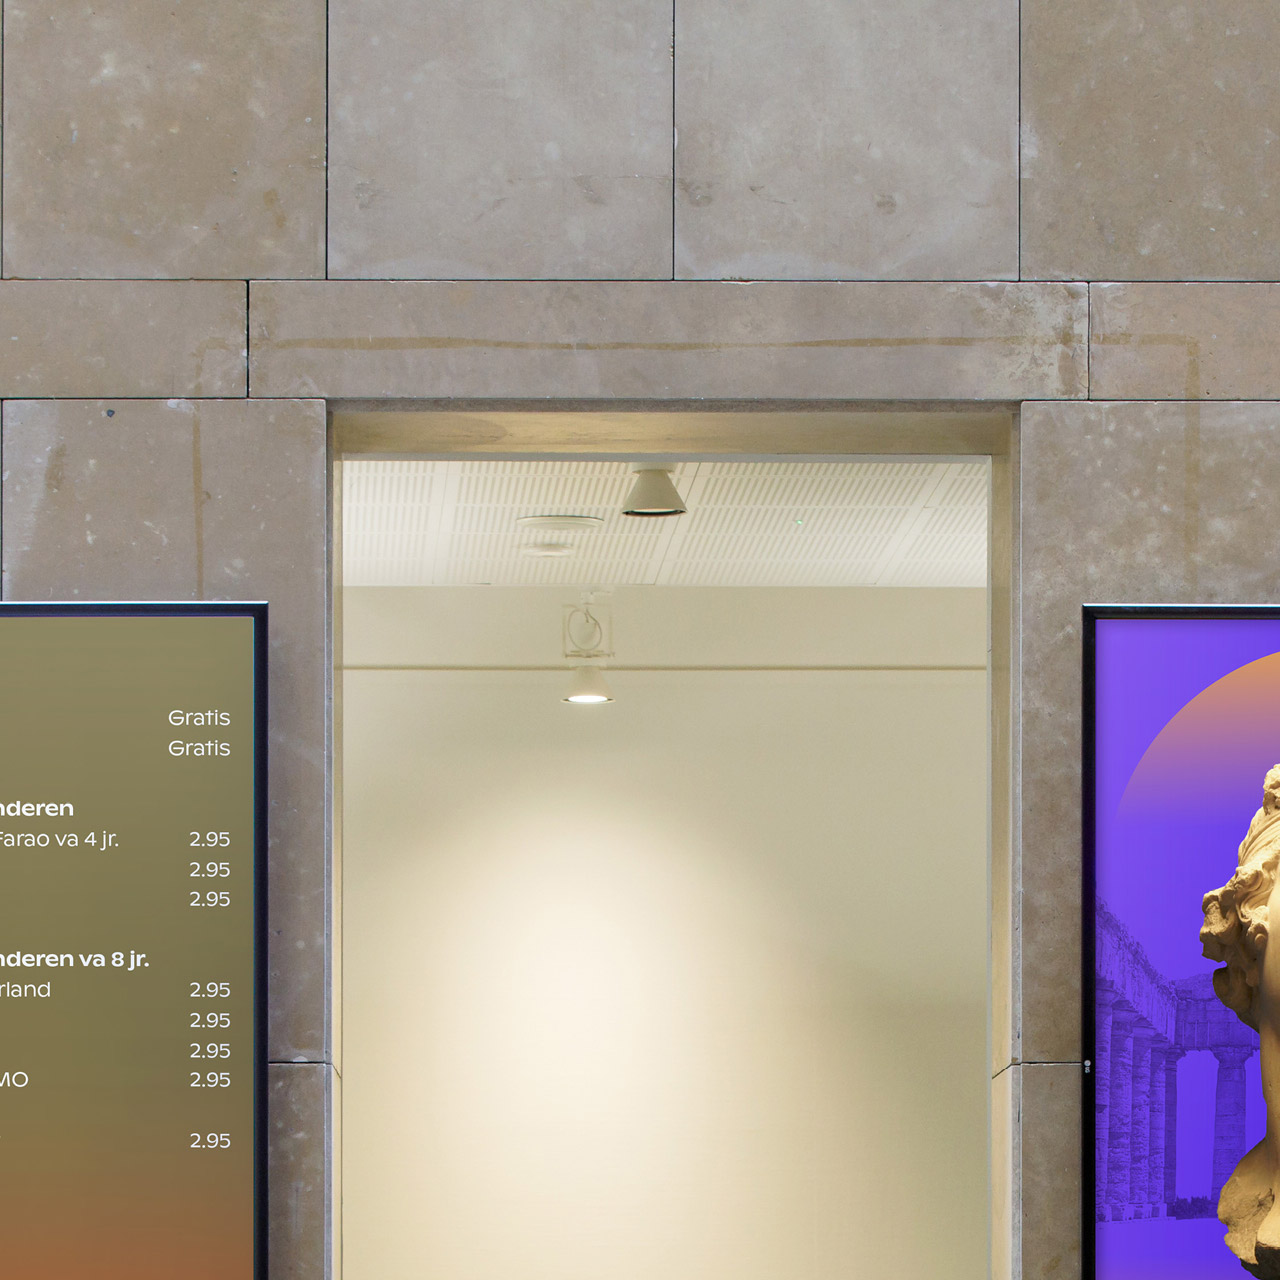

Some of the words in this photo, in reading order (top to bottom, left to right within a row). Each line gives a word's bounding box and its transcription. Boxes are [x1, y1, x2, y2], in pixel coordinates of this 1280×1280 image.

[168, 709, 231, 727] Gratis
[168, 739, 231, 757] Gratis
[54, 833, 80, 848] va
[83, 831, 97, 848] 4
[99, 831, 120, 852] jr.
[189, 831, 231, 848] 2.95
[189, 861, 231, 878] 2.95
[189, 891, 231, 907] 2.95
[78, 952, 107, 968] va
[111, 950, 125, 968] 8
[127, 949, 151, 972] jr.
[189, 981, 231, 998] 2.95
[189, 1012, 231, 1029] 2.95
[189, 1042, 231, 1059] 2.95
[189, 1071, 231, 1088] 2.95
[189, 1132, 231, 1149] 2.95
